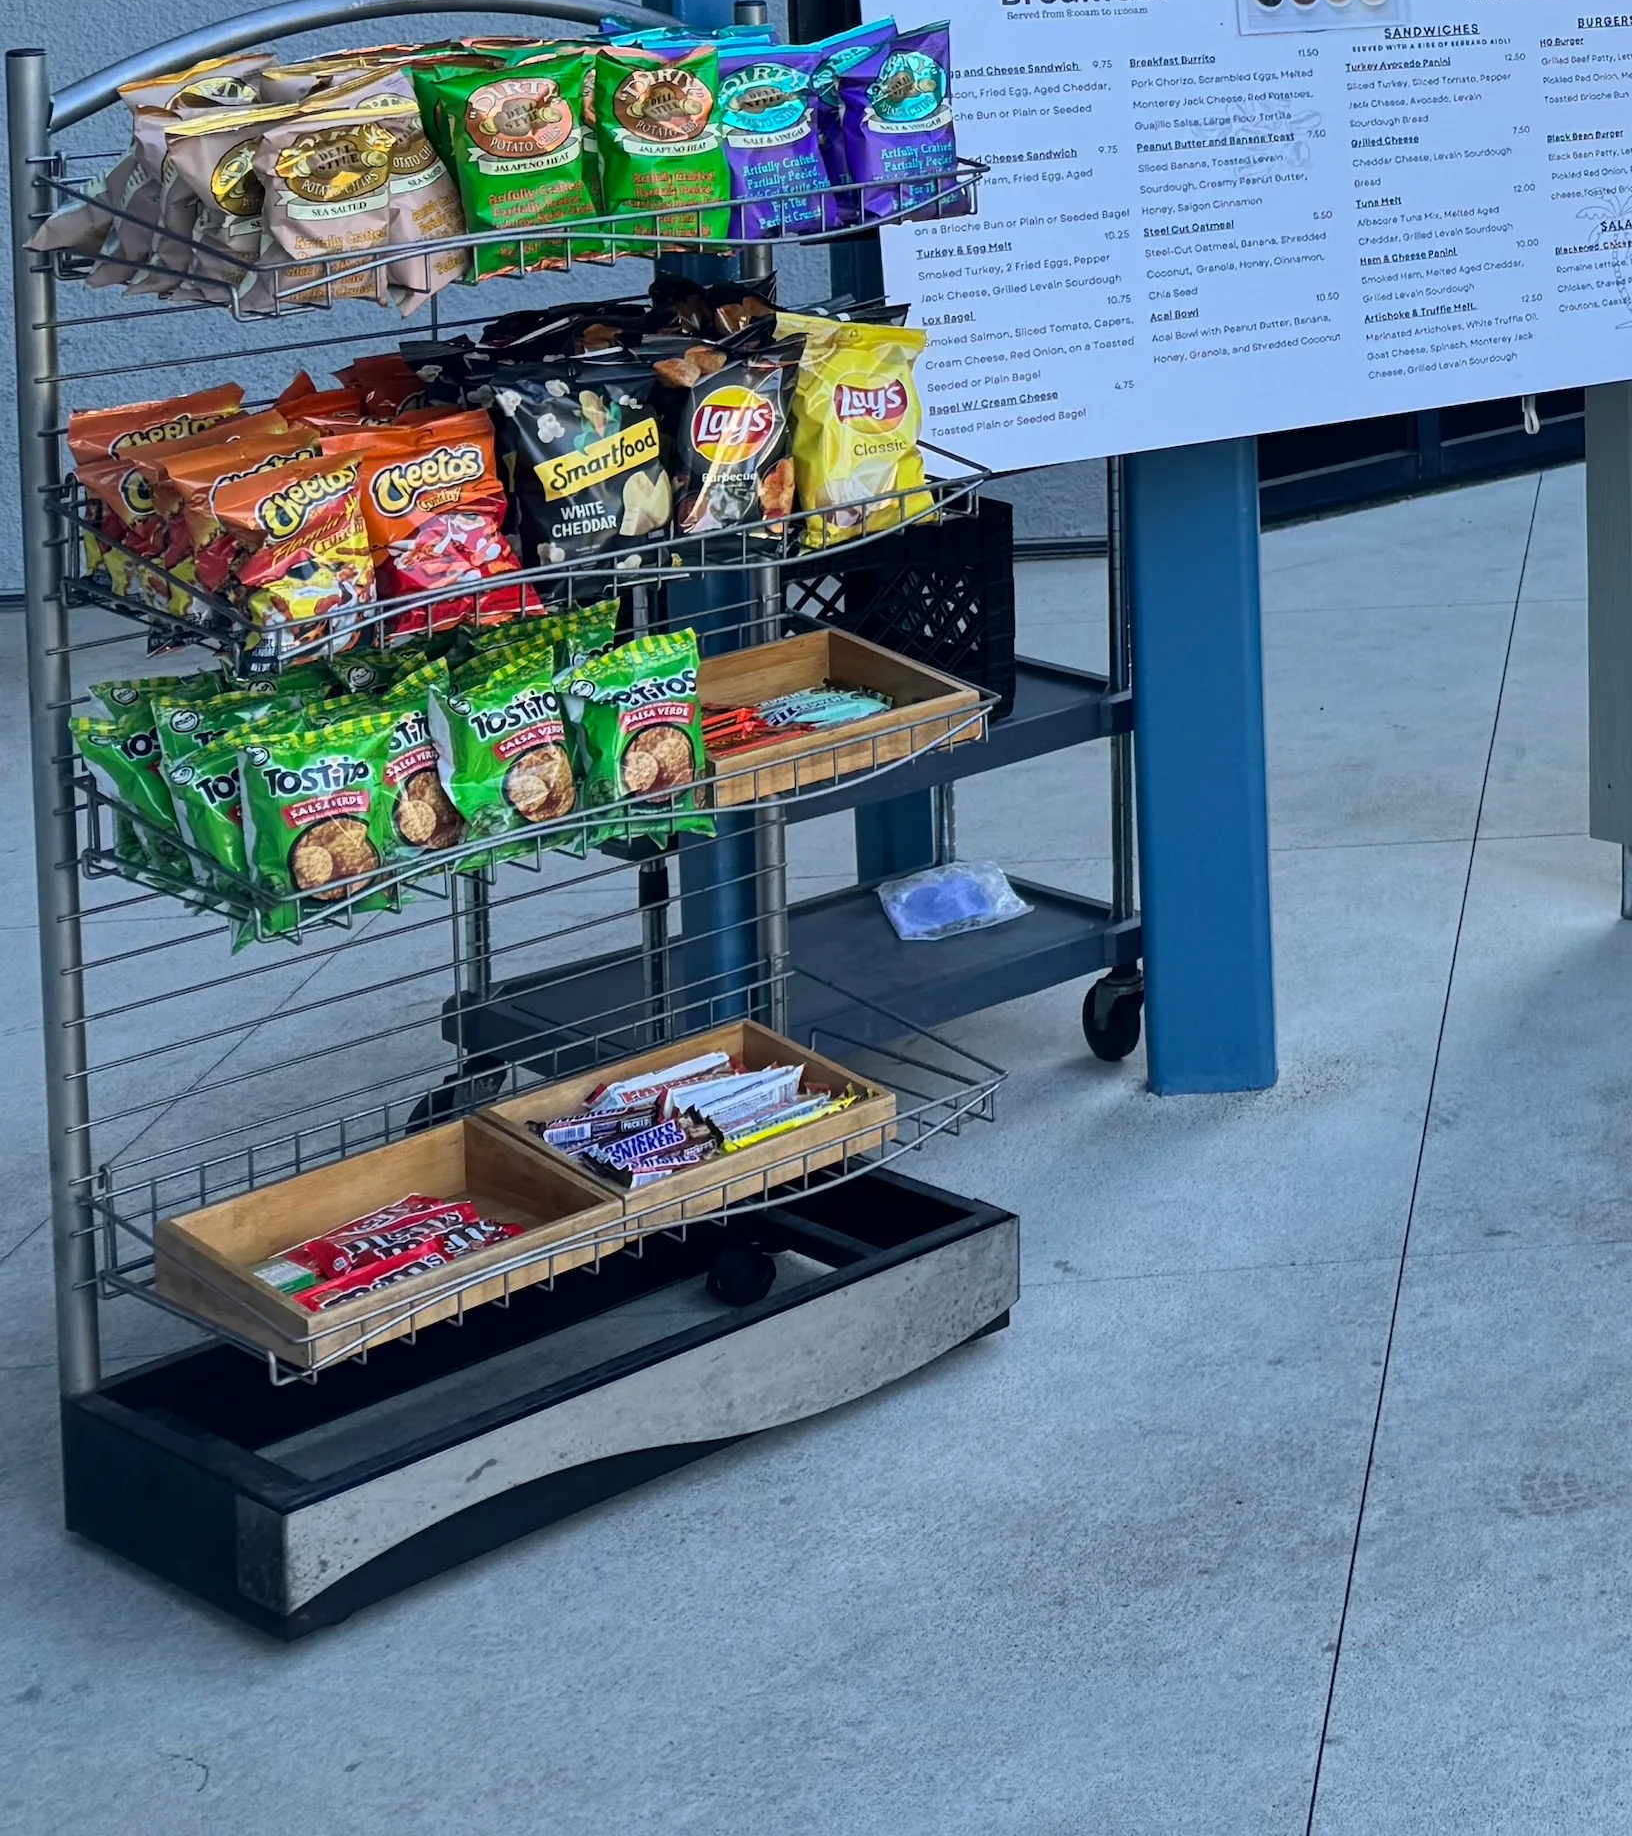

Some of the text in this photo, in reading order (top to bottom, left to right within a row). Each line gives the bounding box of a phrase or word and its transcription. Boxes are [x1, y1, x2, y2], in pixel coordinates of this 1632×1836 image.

[1382, 23, 1480, 39] SANDWICHES
[1092, 60, 1112, 69] 9.75
[1129, 54, 1216, 68] Breakfast Burrito
[1505, 53, 1526, 61] 12.50
[490, 137, 533, 152] POTATO
[743, 136, 764, 145] SALT
[1351, 136, 1419, 148] Grilled Cheese
[1098, 145, 1118, 154] 9.75
[547, 152, 569, 165] HEAT
[743, 160, 780, 176] Artfully
[748, 174, 786, 190] Partially
[1514, 183, 1535, 193] 12.00
[312, 201, 367, 217] SEA SALTED
[1104, 229, 1130, 240] 10.25
[1143, 220, 1234, 238] Steel Cut Oatmeal
[916, 242, 1012, 260] Turkey & Egg Melt
[1107, 294, 1131, 304] 10.75
[922, 314, 976, 327] Lox Bagel
[1114, 380, 1134, 390] 4.75
[839, 382, 903, 420] Lay's
[697, 406, 772, 444] Lay's
[853, 439, 907, 457] Classic
[550, 428, 657, 492] Smartfood
[371, 447, 484, 517] Cheetos
[702, 471, 757, 482] Barbecue
[257, 467, 357, 539] Cheetos
[417, 486, 462, 512] Crunchy
[561, 501, 604, 519] WHITE
[551, 515, 618, 539] CHEDDAR
[624, 705, 690, 725] SALSA VERDE
[499, 732, 534, 753] SALSA
[290, 802, 330, 819] SALSA
[610, 1128, 686, 1165] SNICKERS
